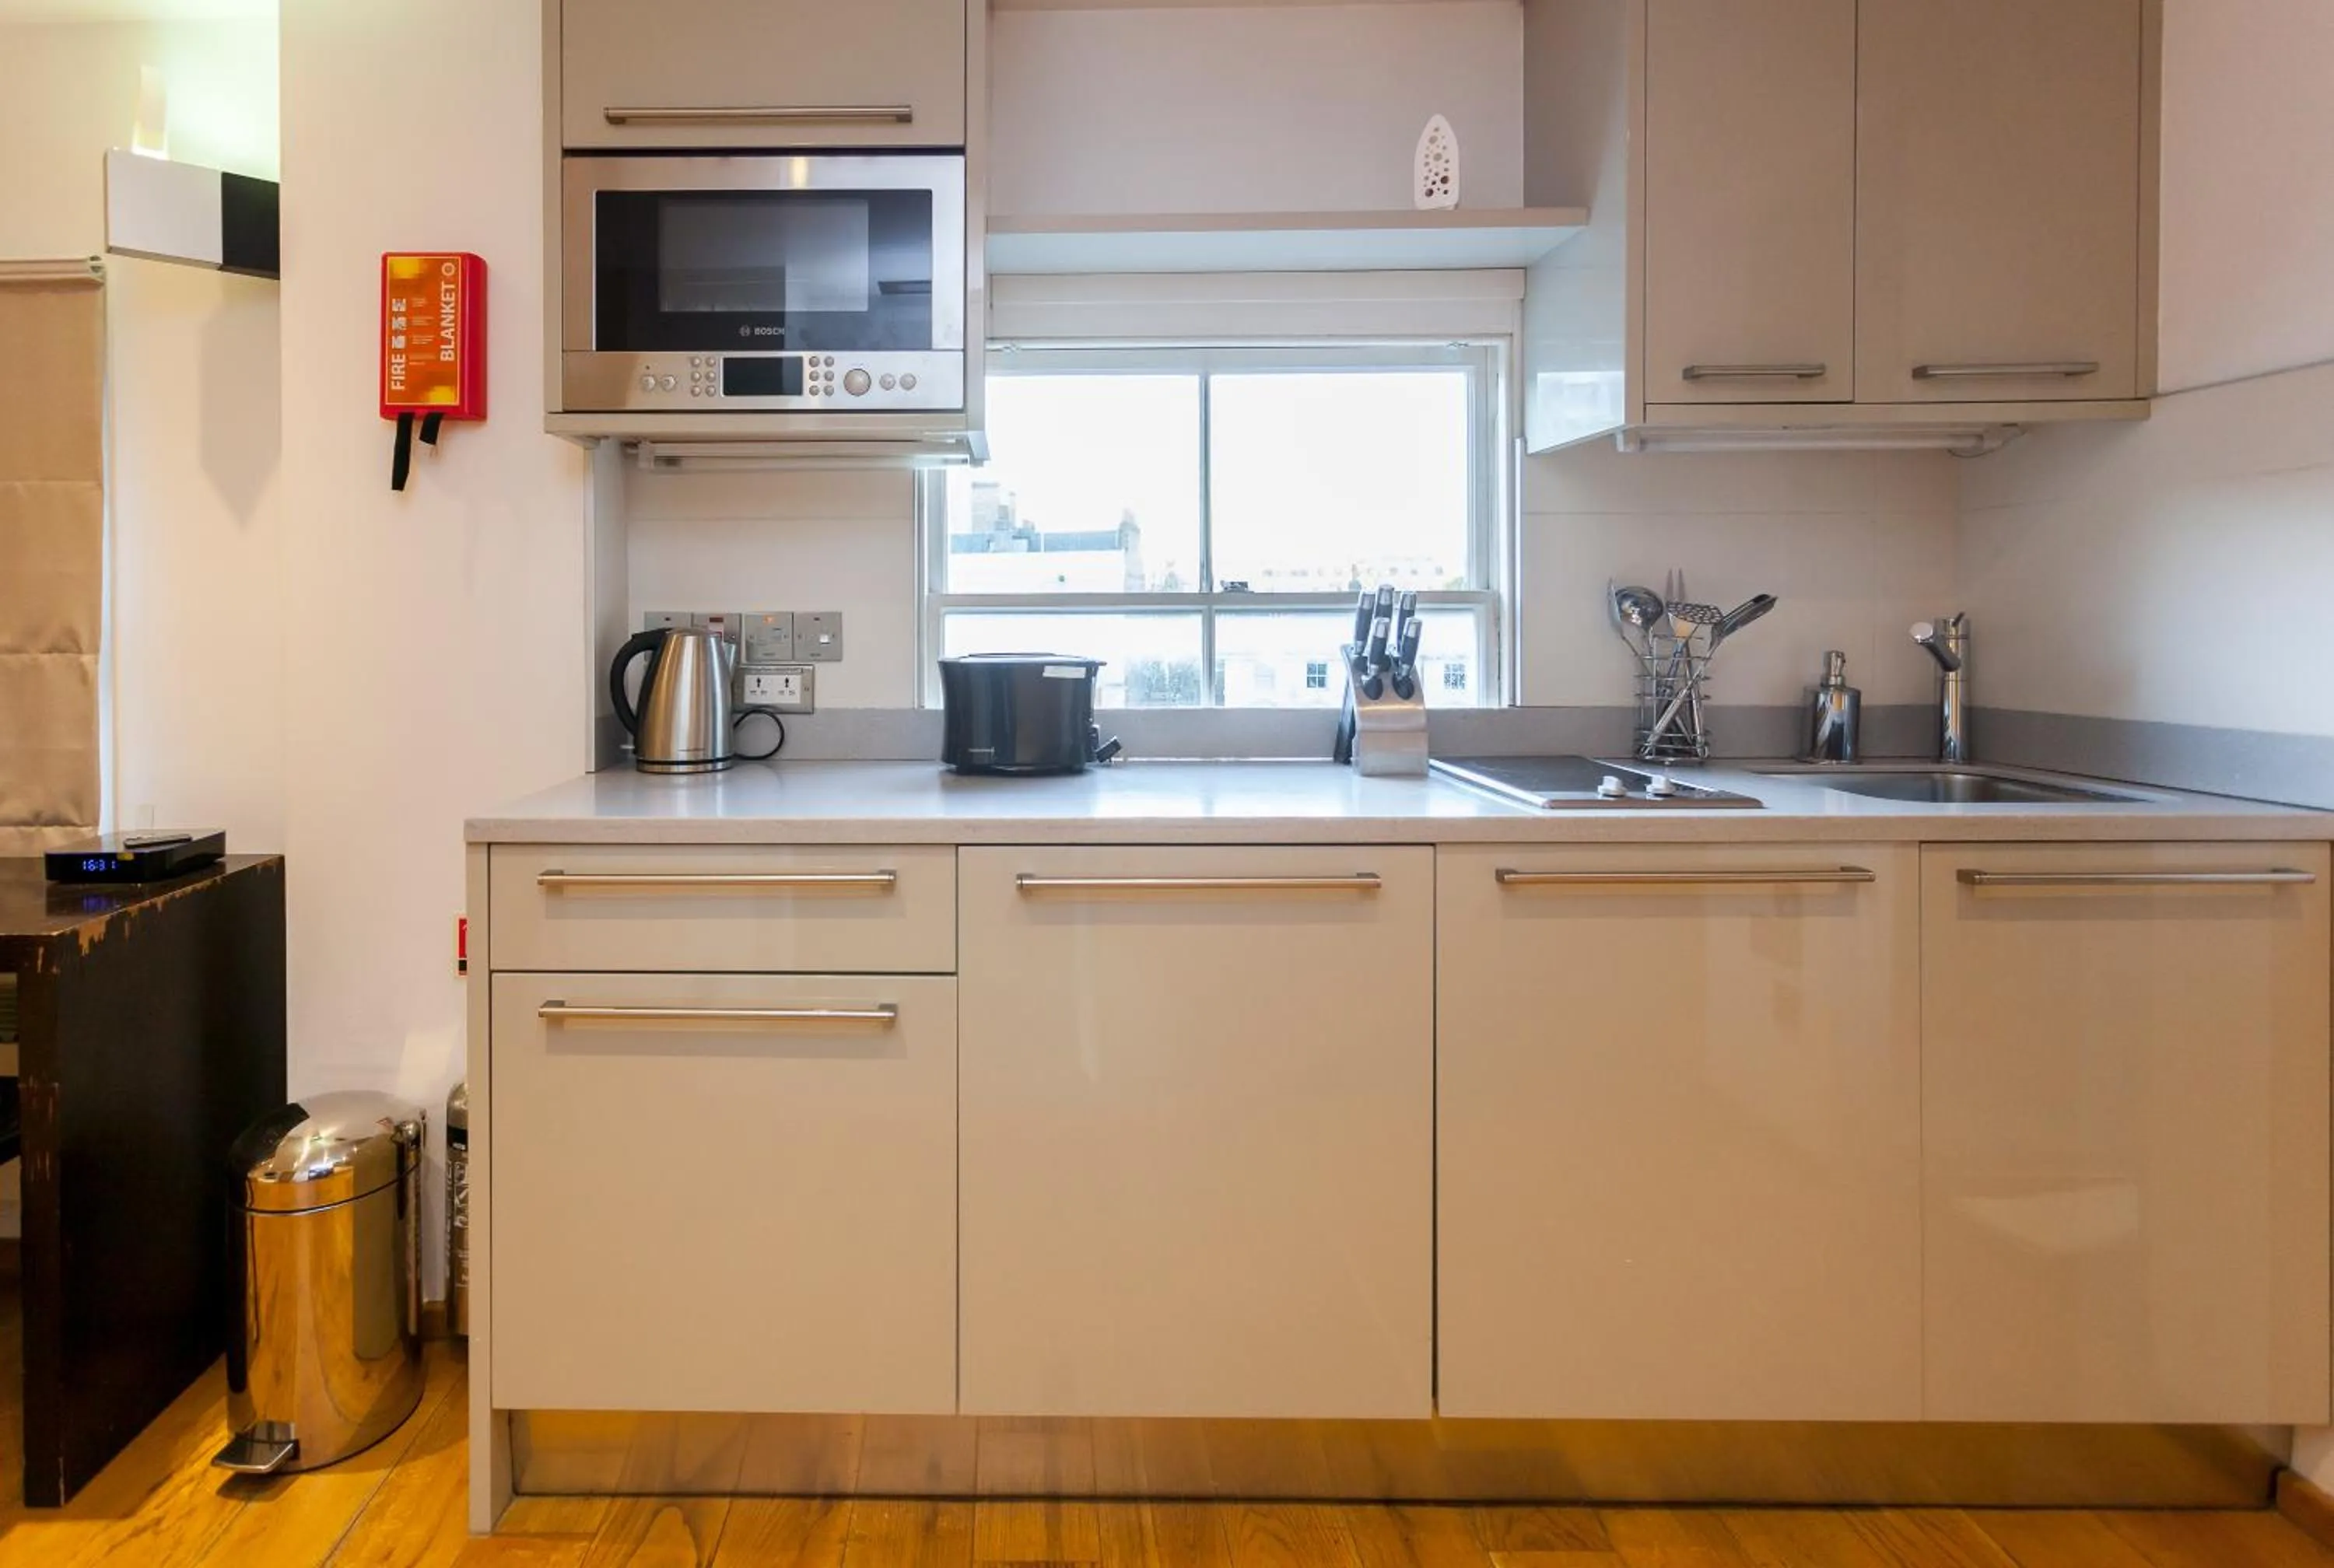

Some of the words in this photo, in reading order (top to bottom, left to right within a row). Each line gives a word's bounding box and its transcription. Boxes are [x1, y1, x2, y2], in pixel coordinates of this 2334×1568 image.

[440, 280, 455, 362] BLANKET
[754, 327, 785, 335] BOSCH
[391, 353, 406, 390] FIRE
